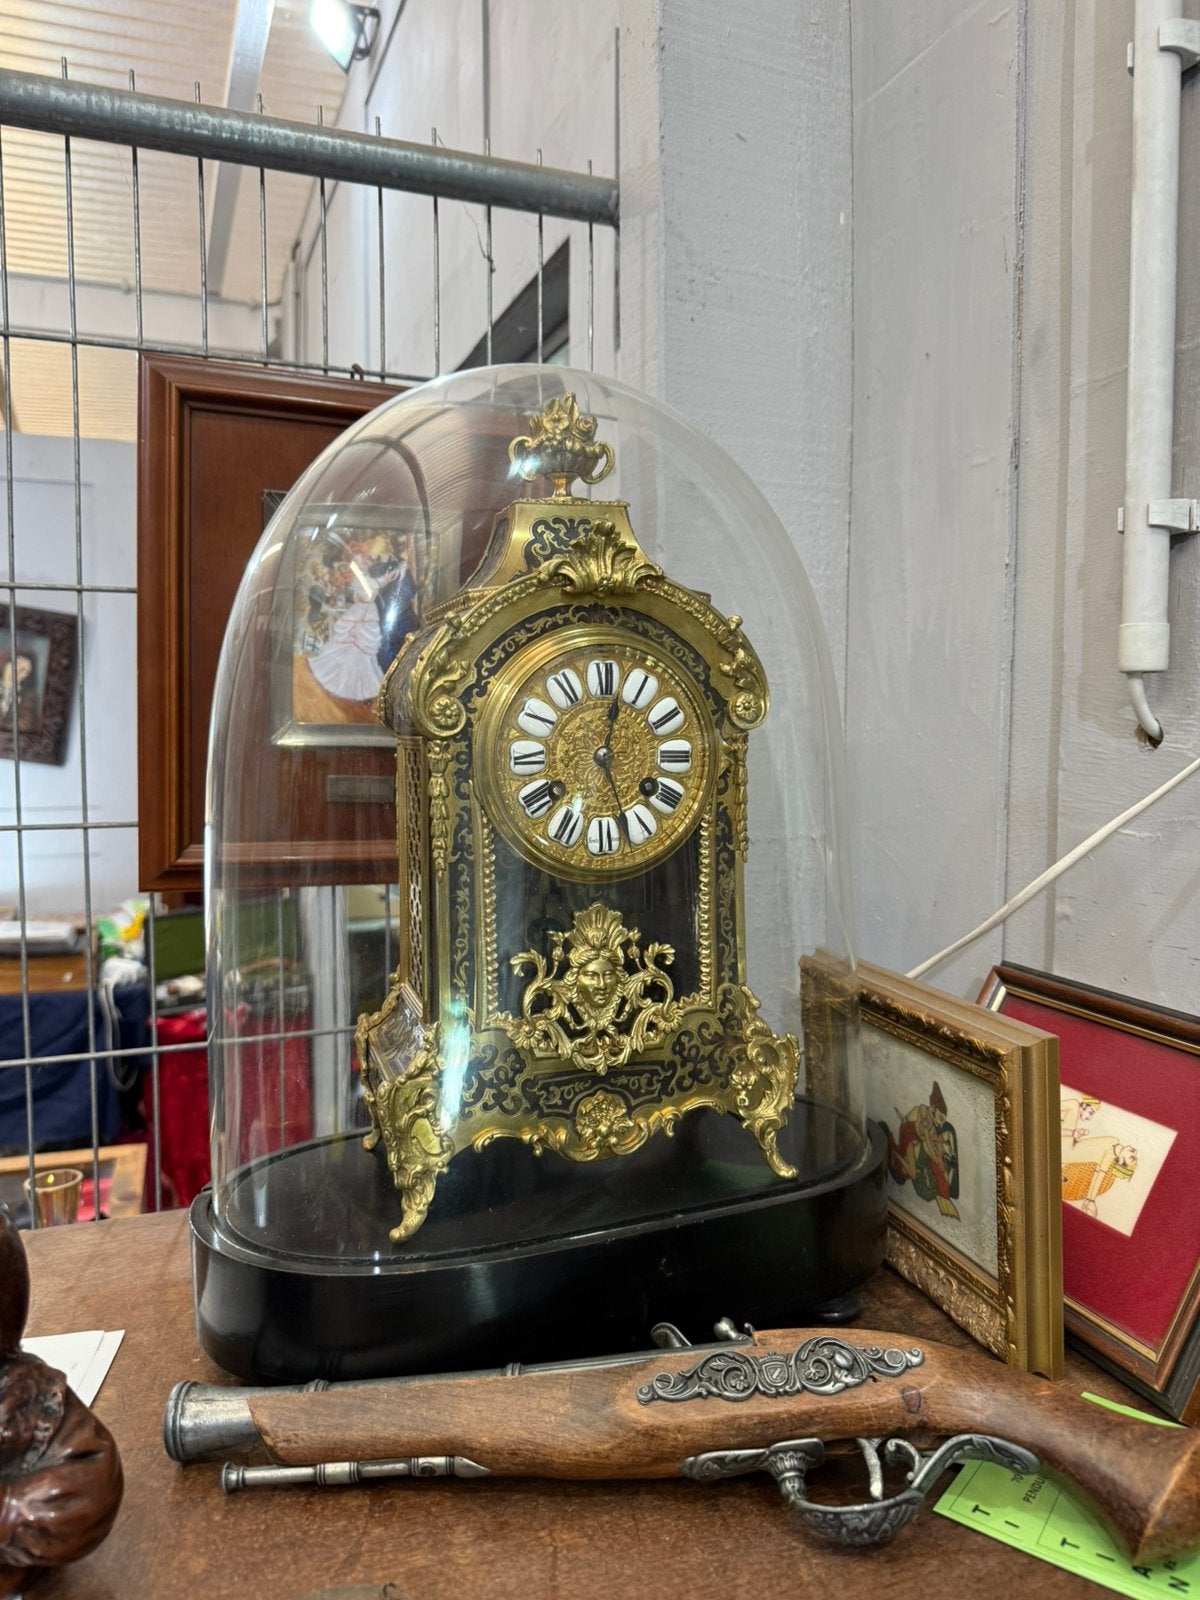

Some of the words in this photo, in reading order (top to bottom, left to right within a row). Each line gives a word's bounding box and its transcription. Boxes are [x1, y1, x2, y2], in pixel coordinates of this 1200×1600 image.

[553, 671, 580, 706] XI
[594, 662, 614, 696] XII
[631, 673, 650, 706] I
[524, 704, 556, 731] X
[651, 706, 681, 730] II
[513, 750, 545, 768] IX
[660, 750, 690, 763] III
[522, 781, 551, 816] VIII
[553, 808, 580, 845] VII
[597, 819, 614, 853] VI
[633, 810, 653, 839] V
